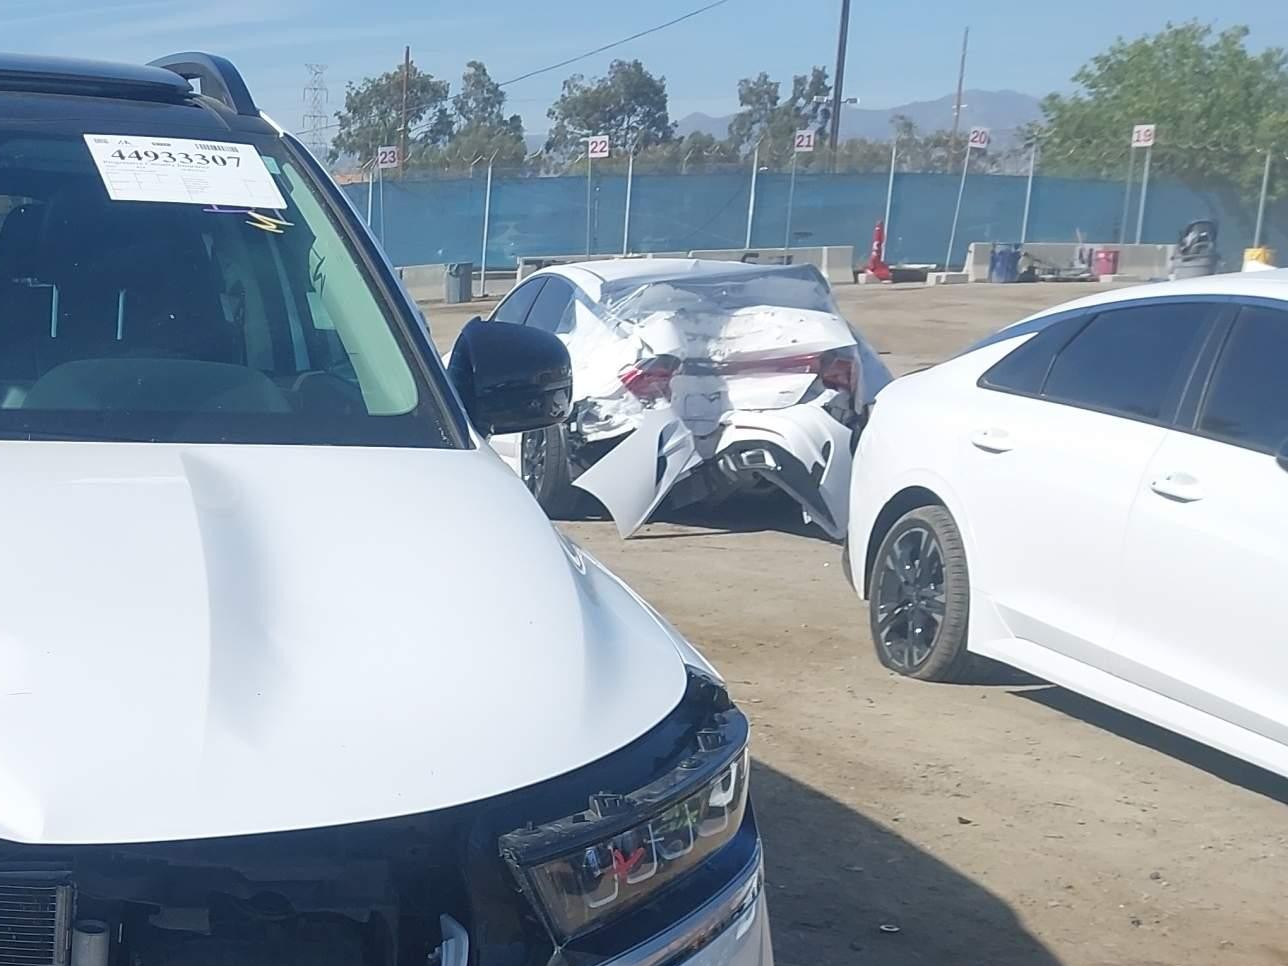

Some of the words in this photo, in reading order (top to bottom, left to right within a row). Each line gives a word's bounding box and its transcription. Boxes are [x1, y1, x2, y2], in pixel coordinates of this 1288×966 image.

[796, 134, 813, 148] 21
[971, 130, 987, 144] 20
[590, 140, 608, 154] 22
[111, 149, 241, 168] 44933307
[379, 150, 396, 164] 23
